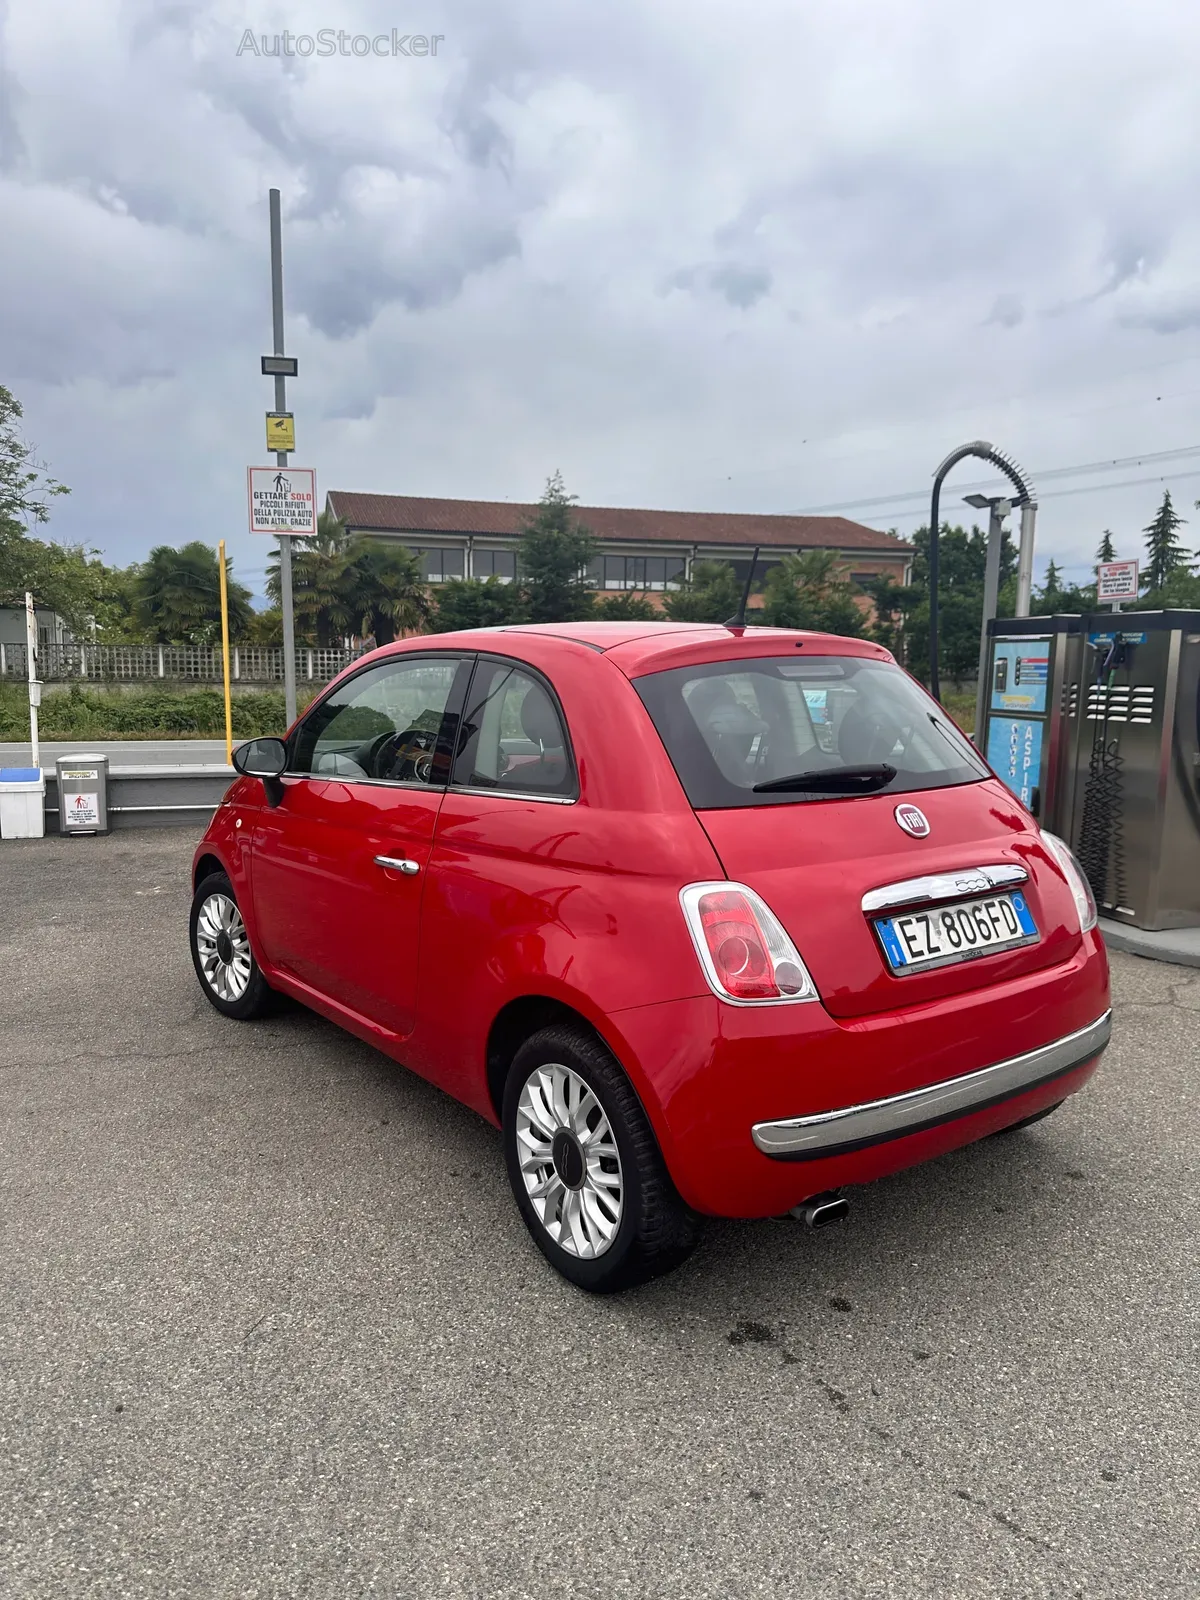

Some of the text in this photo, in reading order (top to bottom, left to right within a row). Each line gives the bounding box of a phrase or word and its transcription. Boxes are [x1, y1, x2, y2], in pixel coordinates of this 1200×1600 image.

[254, 492, 312, 501] GETTARE SOLO
[260, 500, 306, 509] PICCOLI RIFIUTI
[254, 508, 312, 518] DELLA PULIZIA AUTO
[255, 517, 270, 525] NON
[290, 518, 312, 527] GRAZIE
[1020, 725, 1033, 806] ASPIR
[903, 812, 925, 829] FIAT
[955, 878, 986, 892] 500
[898, 899, 1018, 959] EZ 806FD
